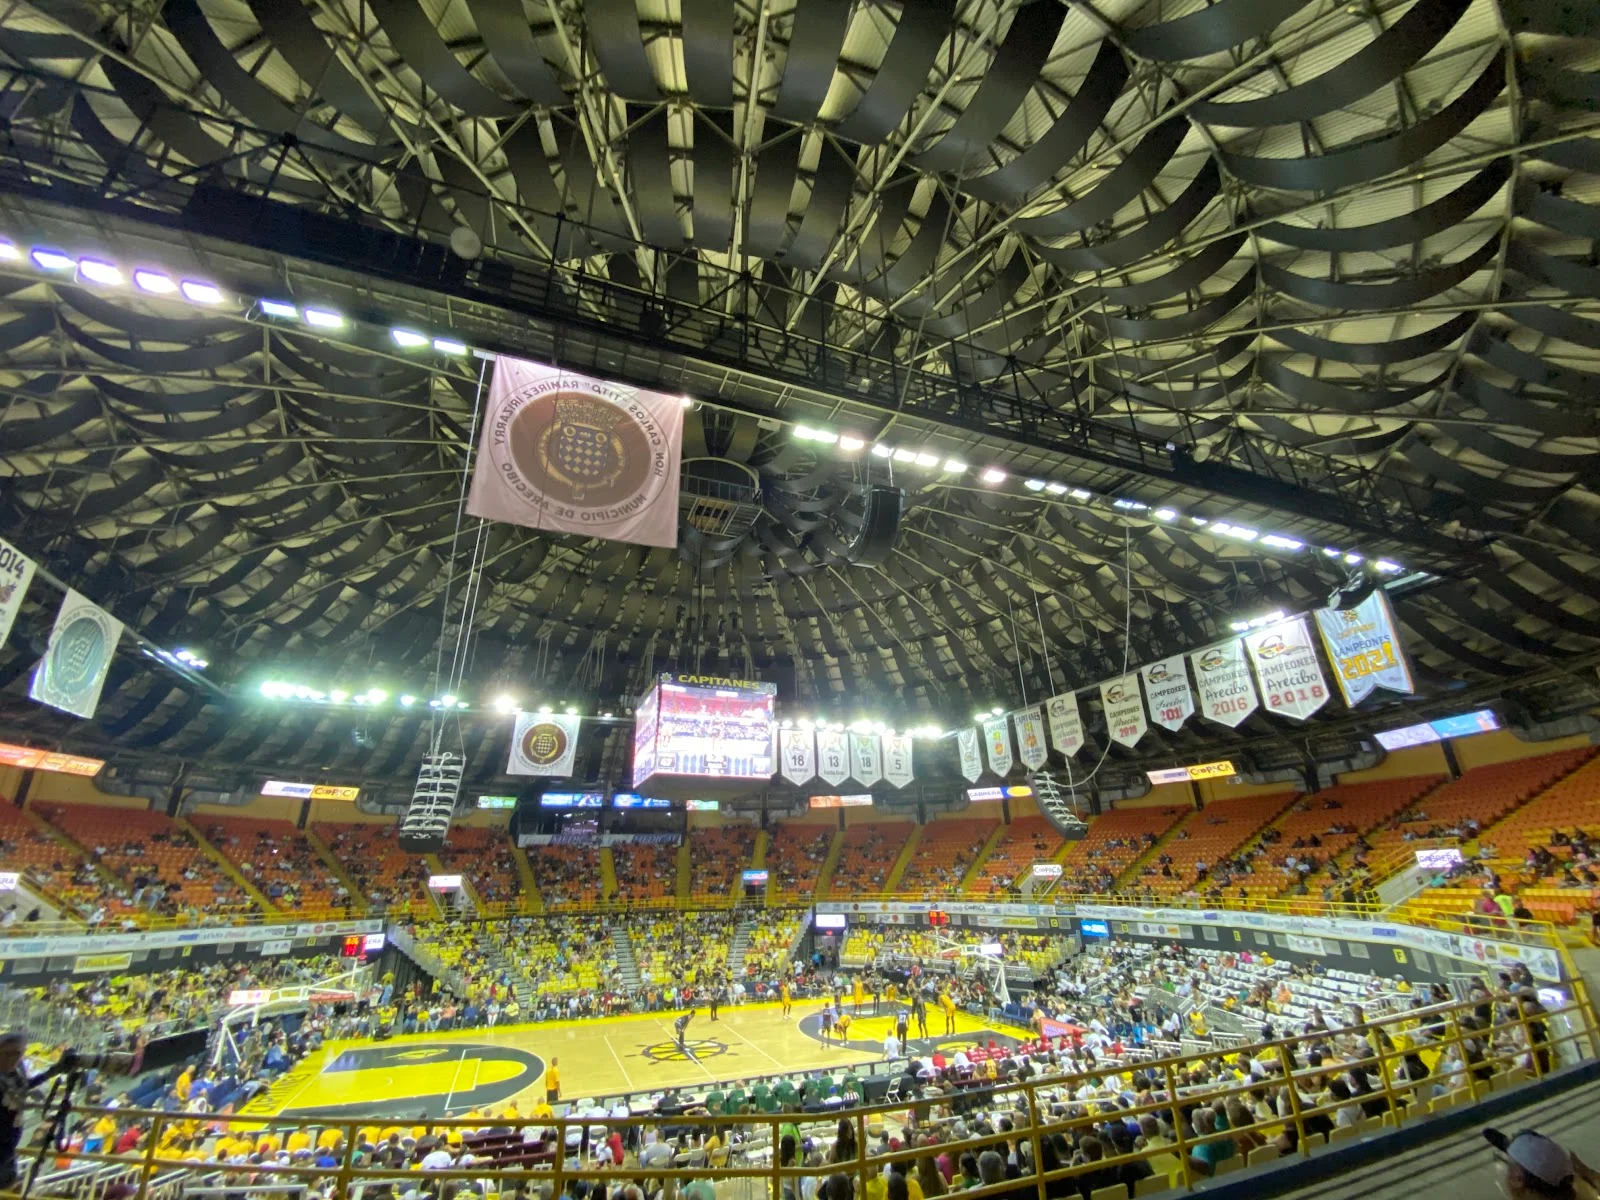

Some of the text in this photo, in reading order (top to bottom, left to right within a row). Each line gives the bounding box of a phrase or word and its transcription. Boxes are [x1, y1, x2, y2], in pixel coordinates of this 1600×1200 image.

[0, 542, 25, 579] 014
[1259, 655, 1317, 677] CAMPEONES
[1339, 641, 1399, 680] 2021
[678, 674, 760, 690] CAPITANES
[1198, 668, 1249, 689] CAMPEONES
[1266, 669, 1318, 692] Arecibo
[1205, 680, 1249, 702] Arecibo
[1269, 685, 1324, 707] 2018
[1211, 696, 1248, 717] 2016
[791, 755, 805, 766] 18
[828, 755, 840, 768] 13
[861, 757, 872, 768] 18
[895, 759, 902, 770] 5
[1396, 951, 1402, 961] F
